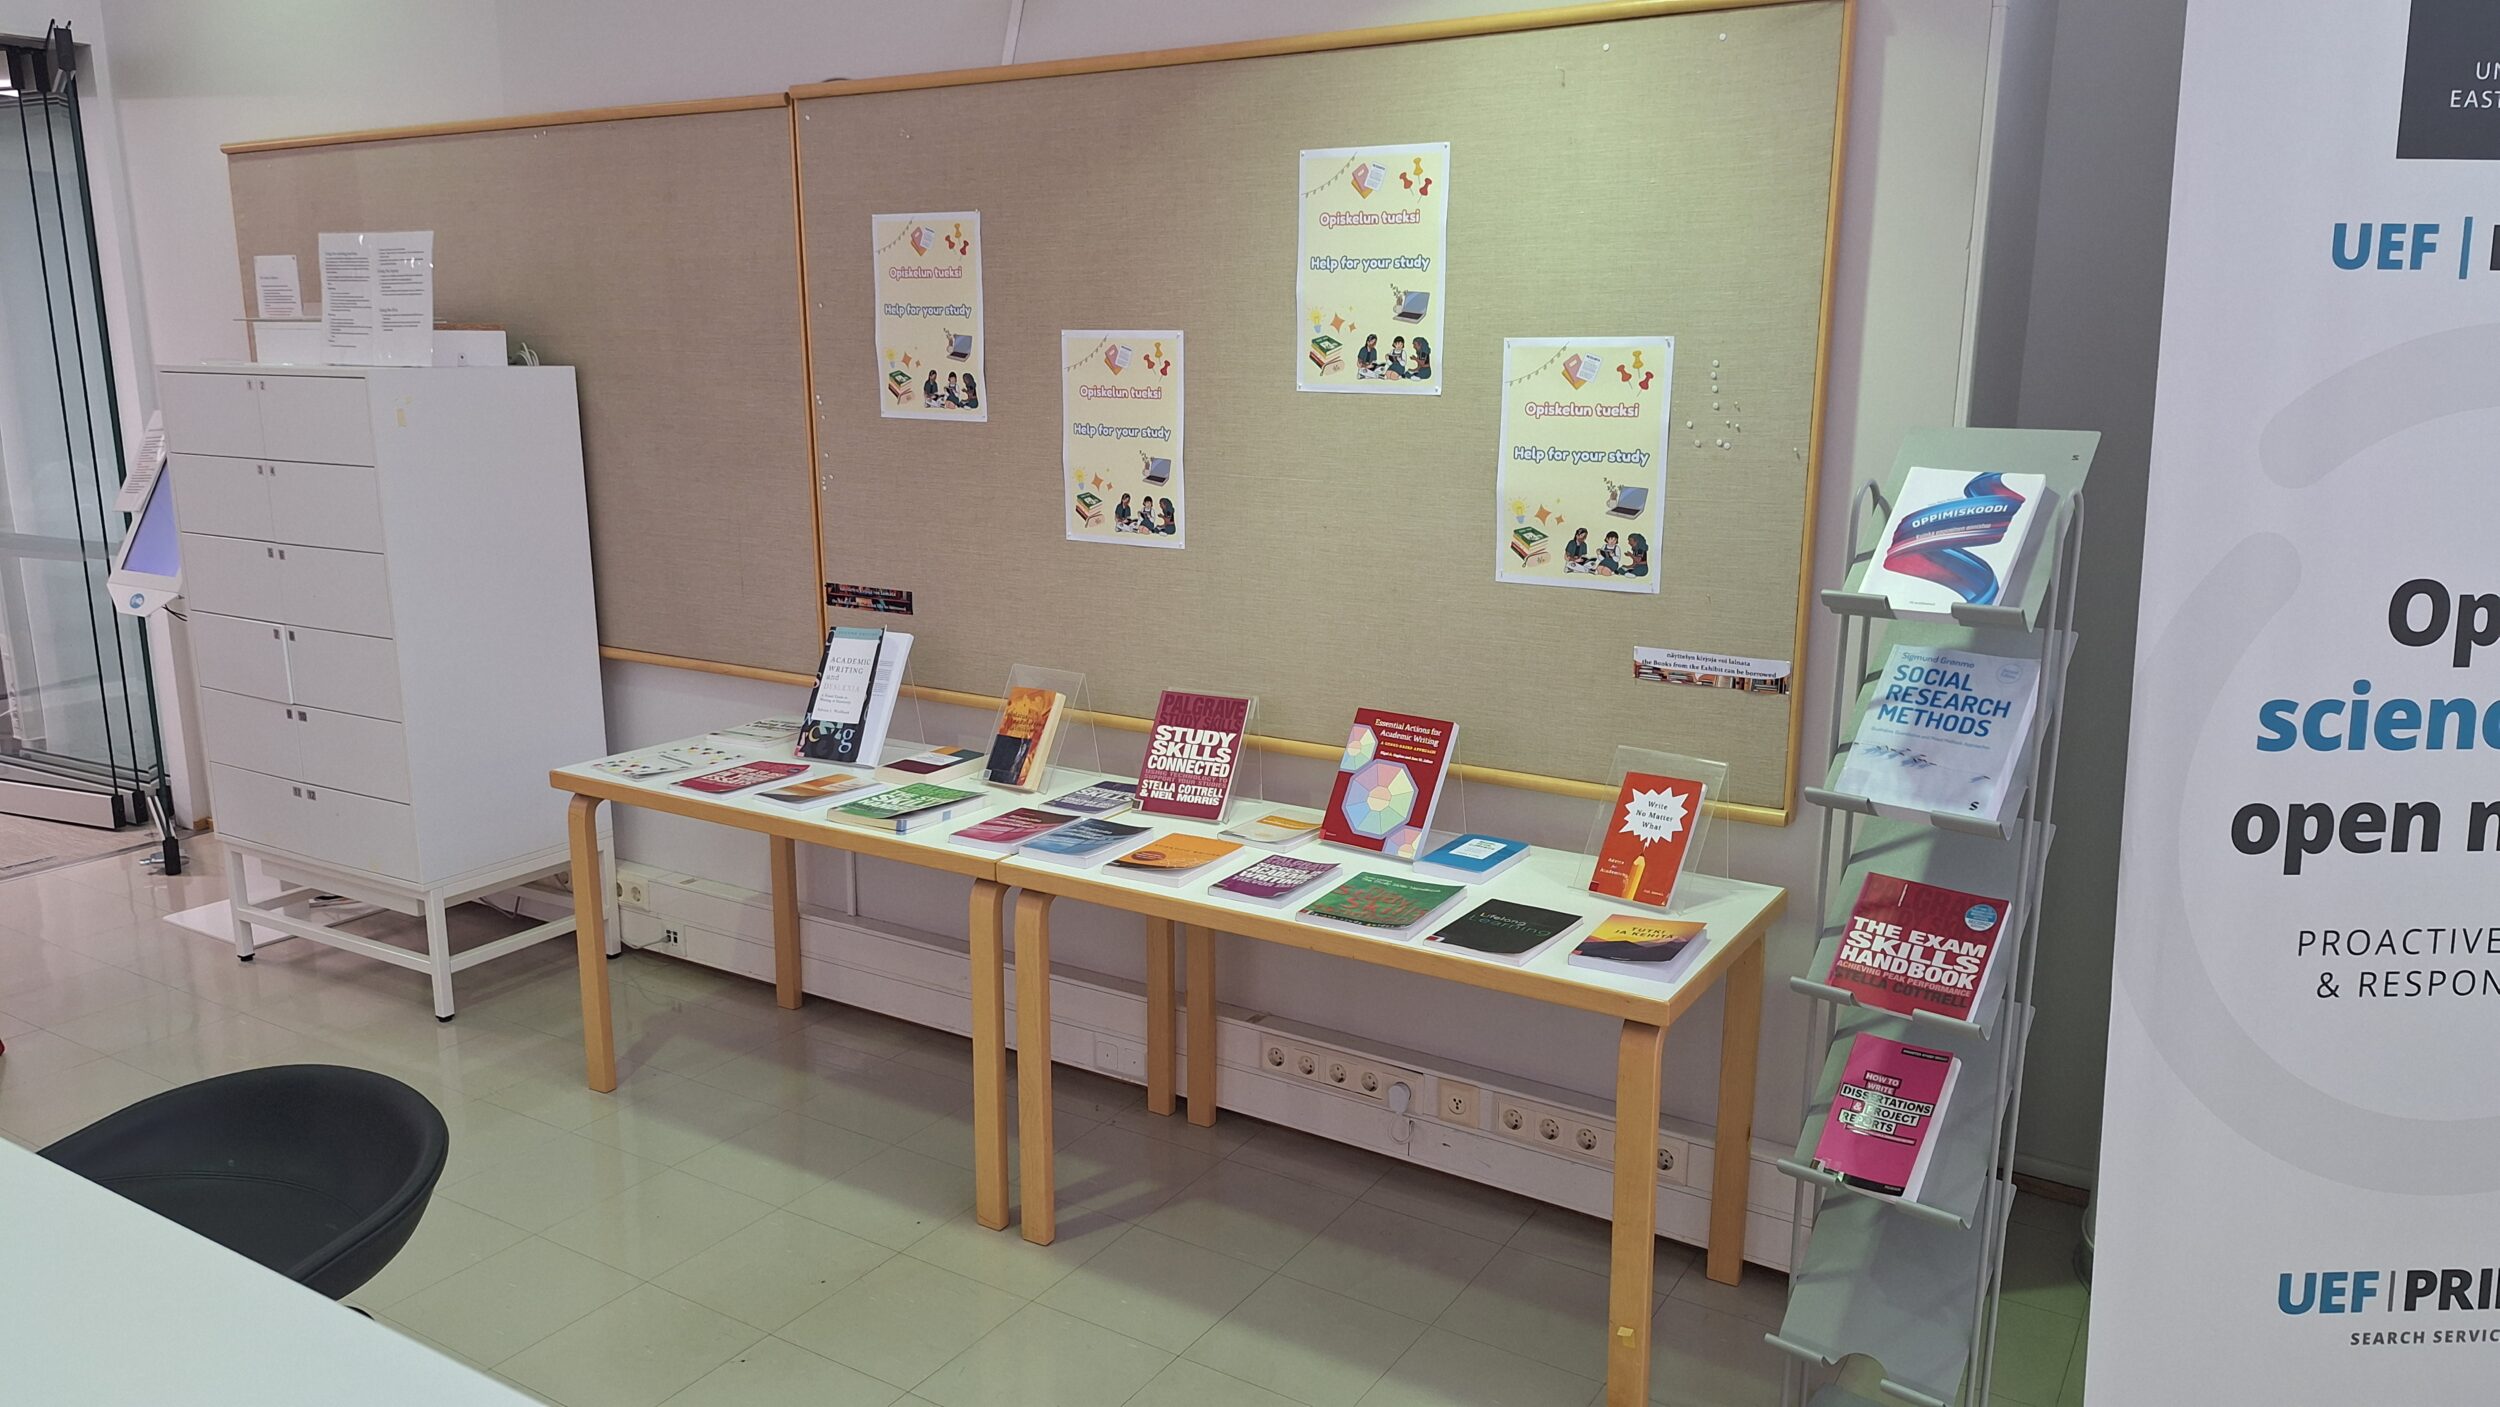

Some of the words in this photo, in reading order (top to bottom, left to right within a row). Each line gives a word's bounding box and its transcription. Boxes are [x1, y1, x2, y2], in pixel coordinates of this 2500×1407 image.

[1319, 210, 1378, 228] Opiskelun
[1381, 209, 1420, 224] tueksi
[2331, 223, 2440, 270] UEF
[1310, 256, 1338, 272] Help
[1340, 256, 1360, 270] for
[1362, 257, 1392, 272] your
[1393, 254, 1430, 272] study
[889, 266, 933, 280] Opiskelun
[934, 266, 962, 278] tueksi
[884, 304, 905, 317] Help
[906, 304, 920, 315] for
[921, 305, 943, 318] your
[944, 304, 971, 318] study
[1079, 385, 1128, 400] Opiskelun
[1130, 386, 1162, 399] tueksi
[1525, 403, 1591, 418] Opiskelun
[1595, 404, 1639, 417] tueksi
[1073, 423, 1096, 437] Help
[1098, 424, 1114, 436] for
[1116, 426, 1139, 440] your
[1141, 425, 1171, 440] study
[1513, 446, 1545, 463] Help
[1548, 448, 1568, 461] for
[1572, 450, 1603, 464] your
[1607, 449, 1649, 466] study
[1912, 505, 2008, 528] OPPIMISKOODI
[2388, 578, 2500, 668] Op
[830, 657, 872, 666] ACADEMIC
[1729, 658, 1750, 667] lainata
[1902, 652, 1939, 664] Sigmund
[828, 666, 864, 675] WRITING
[1673, 661, 1688, 669] from
[1745, 669, 1777, 678] borrowed
[1893, 665, 1973, 691] SOCIAL
[1162, 694, 1245, 719] PALGRAVE
[1885, 684, 2011, 718] RESEARCH
[1160, 712, 1199, 727] STUDY
[1202, 716, 1241, 731] SKILLS
[1375, 719, 1404, 730] Essential
[1405, 724, 1430, 734] Actions
[1431, 728, 1442, 736] for
[1877, 703, 1992, 737] METHODS
[1155, 725, 1237, 747] STUDY
[1380, 730, 1412, 741] Academic
[1414, 735, 1439, 747] Writing
[1151, 740, 1232, 762] SKILLS
[1147, 755, 1230, 777] CONNECTED
[1170, 771, 1217, 781] TECHNOLOGY
[1140, 788, 1148, 797] &
[1151, 790, 1174, 801] NEIL
[1176, 794, 1220, 806] MORRIS
[1142, 780, 1175, 792] STELLA
[1178, 784, 1223, 798] COTTRELL
[1648, 801, 1668, 810] Write
[1636, 809, 1646, 817] No
[1649, 811, 1673, 822] Matter
[1642, 821, 1662, 830] What
[2230, 801, 2442, 875] open
[1469, 915, 1551, 937] Learning
[1479, 912, 1527, 927] Lifelong
[1853, 916, 1902, 940] THE
[1908, 931, 1988, 958] EXAM
[2298, 928, 2500, 957] PROACTIVE
[1846, 930, 1980, 974] SKILLS
[1840, 944, 1977, 990] HANDBOOK
[1835, 967, 1887, 988] STELLA
[1893, 984, 1967, 1008] COTTRELL
[1837, 960, 1881, 977] ACHIEVING
[1883, 972, 1905, 984] PEAK
[1907, 978, 1972, 997] PERFORMANCE
[2316, 971, 2340, 998] &
[2358, 969, 2500, 998] RESPON
[1866, 1072, 1887, 1083] HOW
[1888, 1078, 1900, 1087] TO
[1867, 1082, 1895, 1094] WRITE
[1843, 1085, 1931, 1114] DISSERTATIONS
[1842, 1111, 1894, 1133] REPORTS
[1853, 1101, 1862, 1111] &
[1866, 1104, 1918, 1124] PROJECT
[2278, 1271, 2380, 1315] UEF
[2350, 1331, 2425, 1346] SEARCH
[2432, 1328, 2500, 1344] SERVIC
